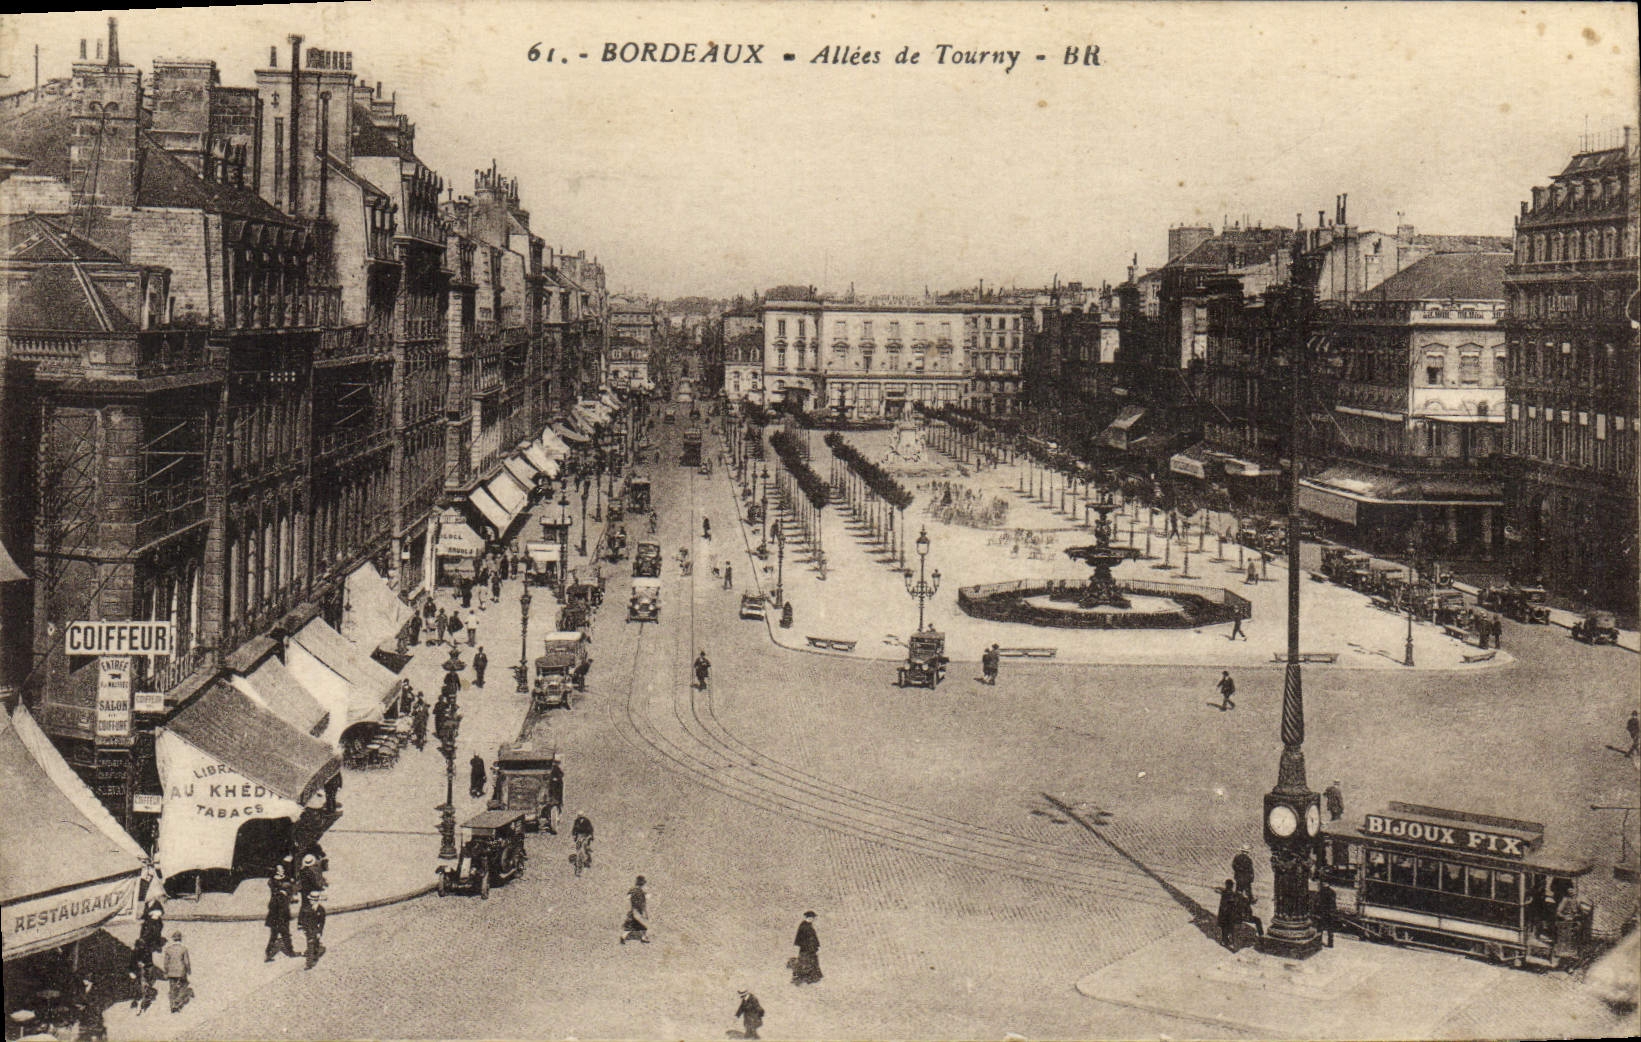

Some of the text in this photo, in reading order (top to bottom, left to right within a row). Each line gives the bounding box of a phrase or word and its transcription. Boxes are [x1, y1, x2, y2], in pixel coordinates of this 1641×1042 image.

[70, 625, 167, 651] COIFFEUR
[99, 700, 128, 712] SALON
[170, 783, 194, 800] AU
[196, 804, 264, 819] TABACS
[1368, 816, 1521, 855] BIJOUX FIX
